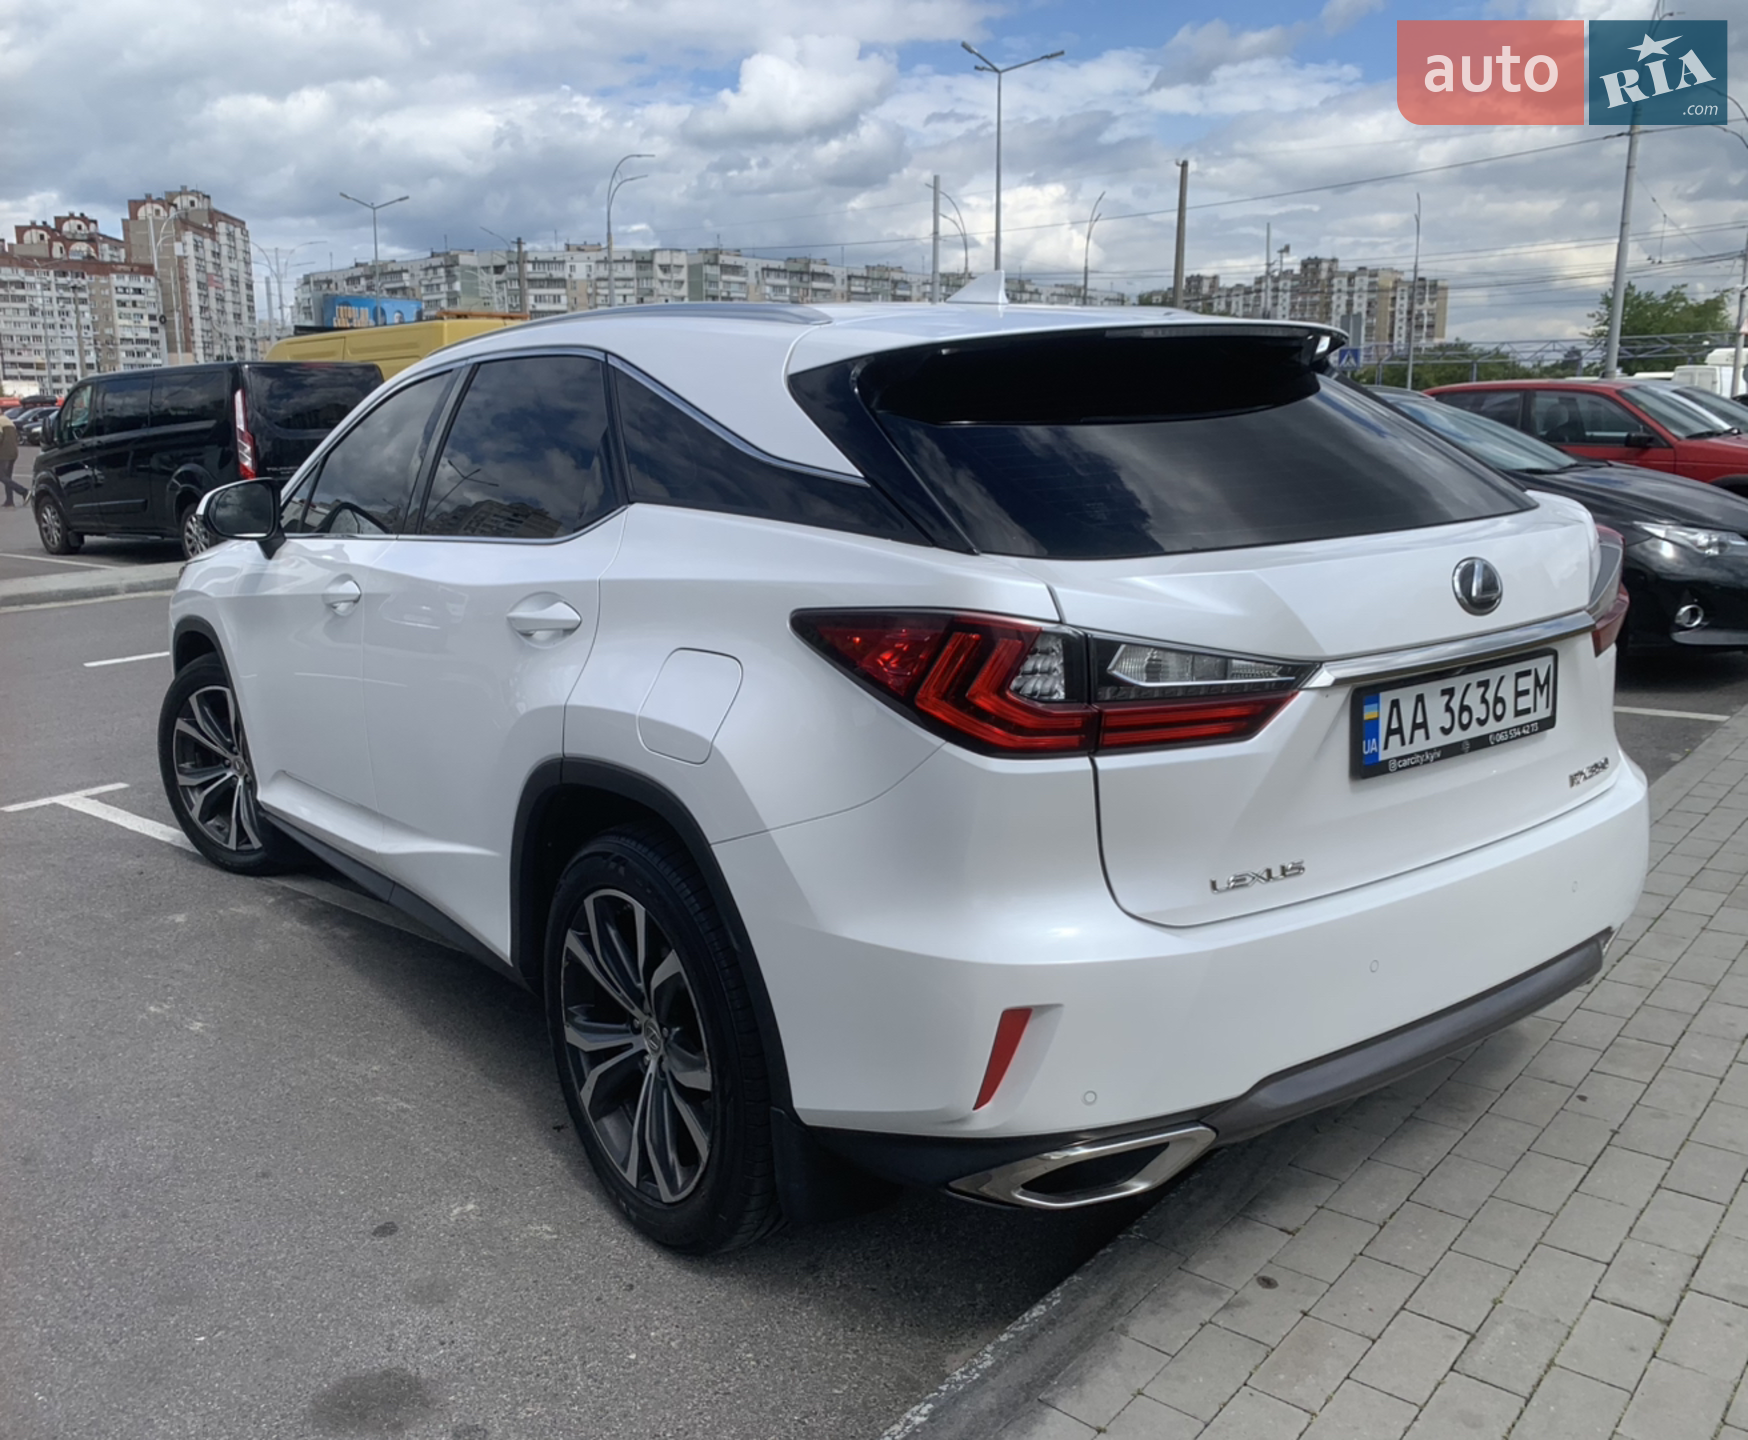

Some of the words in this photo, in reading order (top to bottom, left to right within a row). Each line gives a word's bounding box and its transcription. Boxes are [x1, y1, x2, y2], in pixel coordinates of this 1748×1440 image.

[1383, 693, 1431, 751] AA
[1439, 675, 1507, 736] 3636
[1514, 663, 1552, 719] EM
[1363, 738, 1378, 755] UA
[1210, 859, 1306, 894] LEXUS
